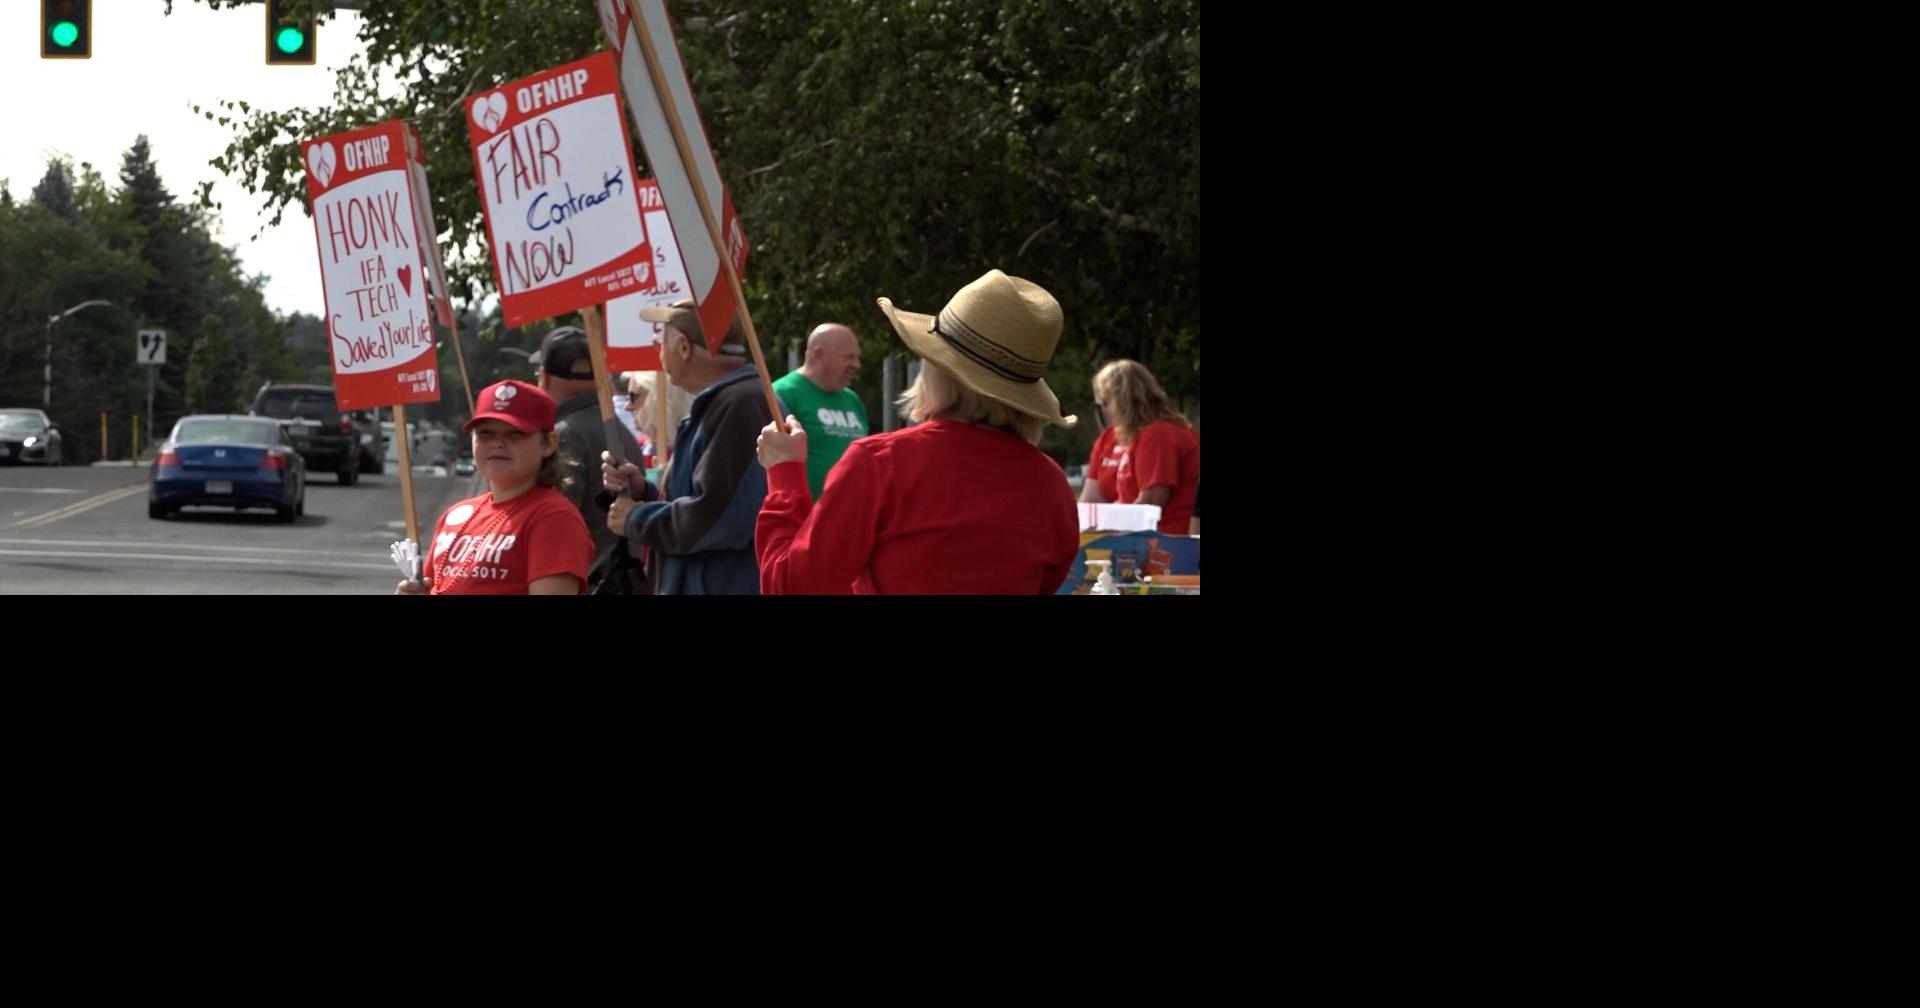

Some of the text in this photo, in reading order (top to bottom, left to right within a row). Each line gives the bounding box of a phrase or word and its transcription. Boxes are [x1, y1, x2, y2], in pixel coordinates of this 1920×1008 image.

[516, 69, 589, 113] OFNHP
[343, 134, 390, 172] OFNHP
[487, 118, 561, 205] FAIR
[326, 189, 409, 263] HONK
[505, 226, 574, 293] NOW
[345, 282, 399, 321] TECH
[472, 566, 508, 580] 5017
